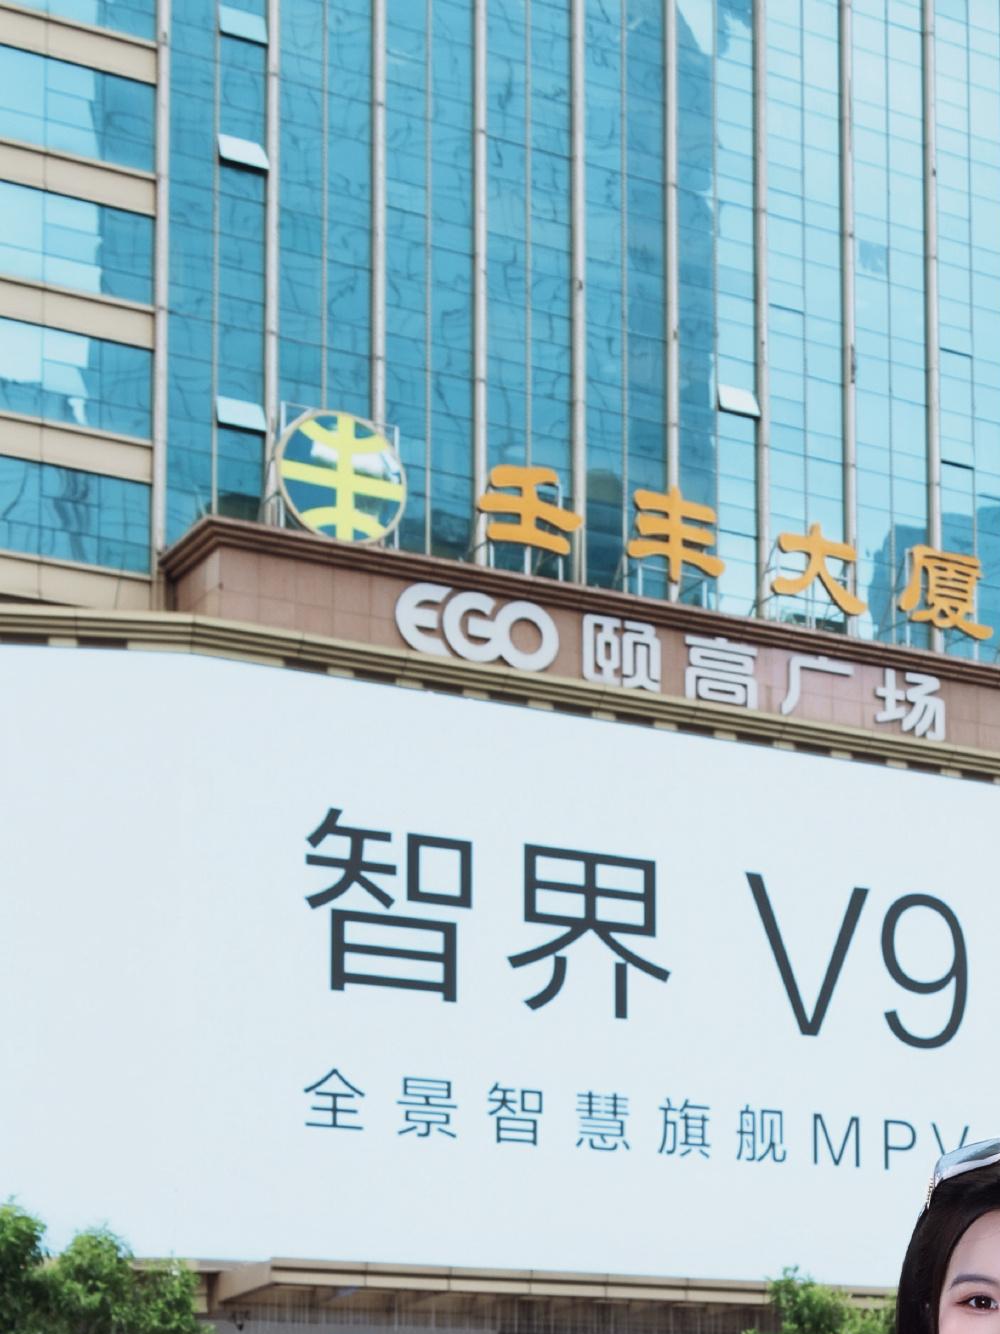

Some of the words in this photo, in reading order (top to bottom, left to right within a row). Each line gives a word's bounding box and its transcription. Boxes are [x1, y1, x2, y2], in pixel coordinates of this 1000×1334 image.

[395, 582, 559, 673] EGO
[581, 613, 947, 741] 颐高广场
[305, 807, 671, 1020] 智界
[745, 871, 969, 1050] V9
